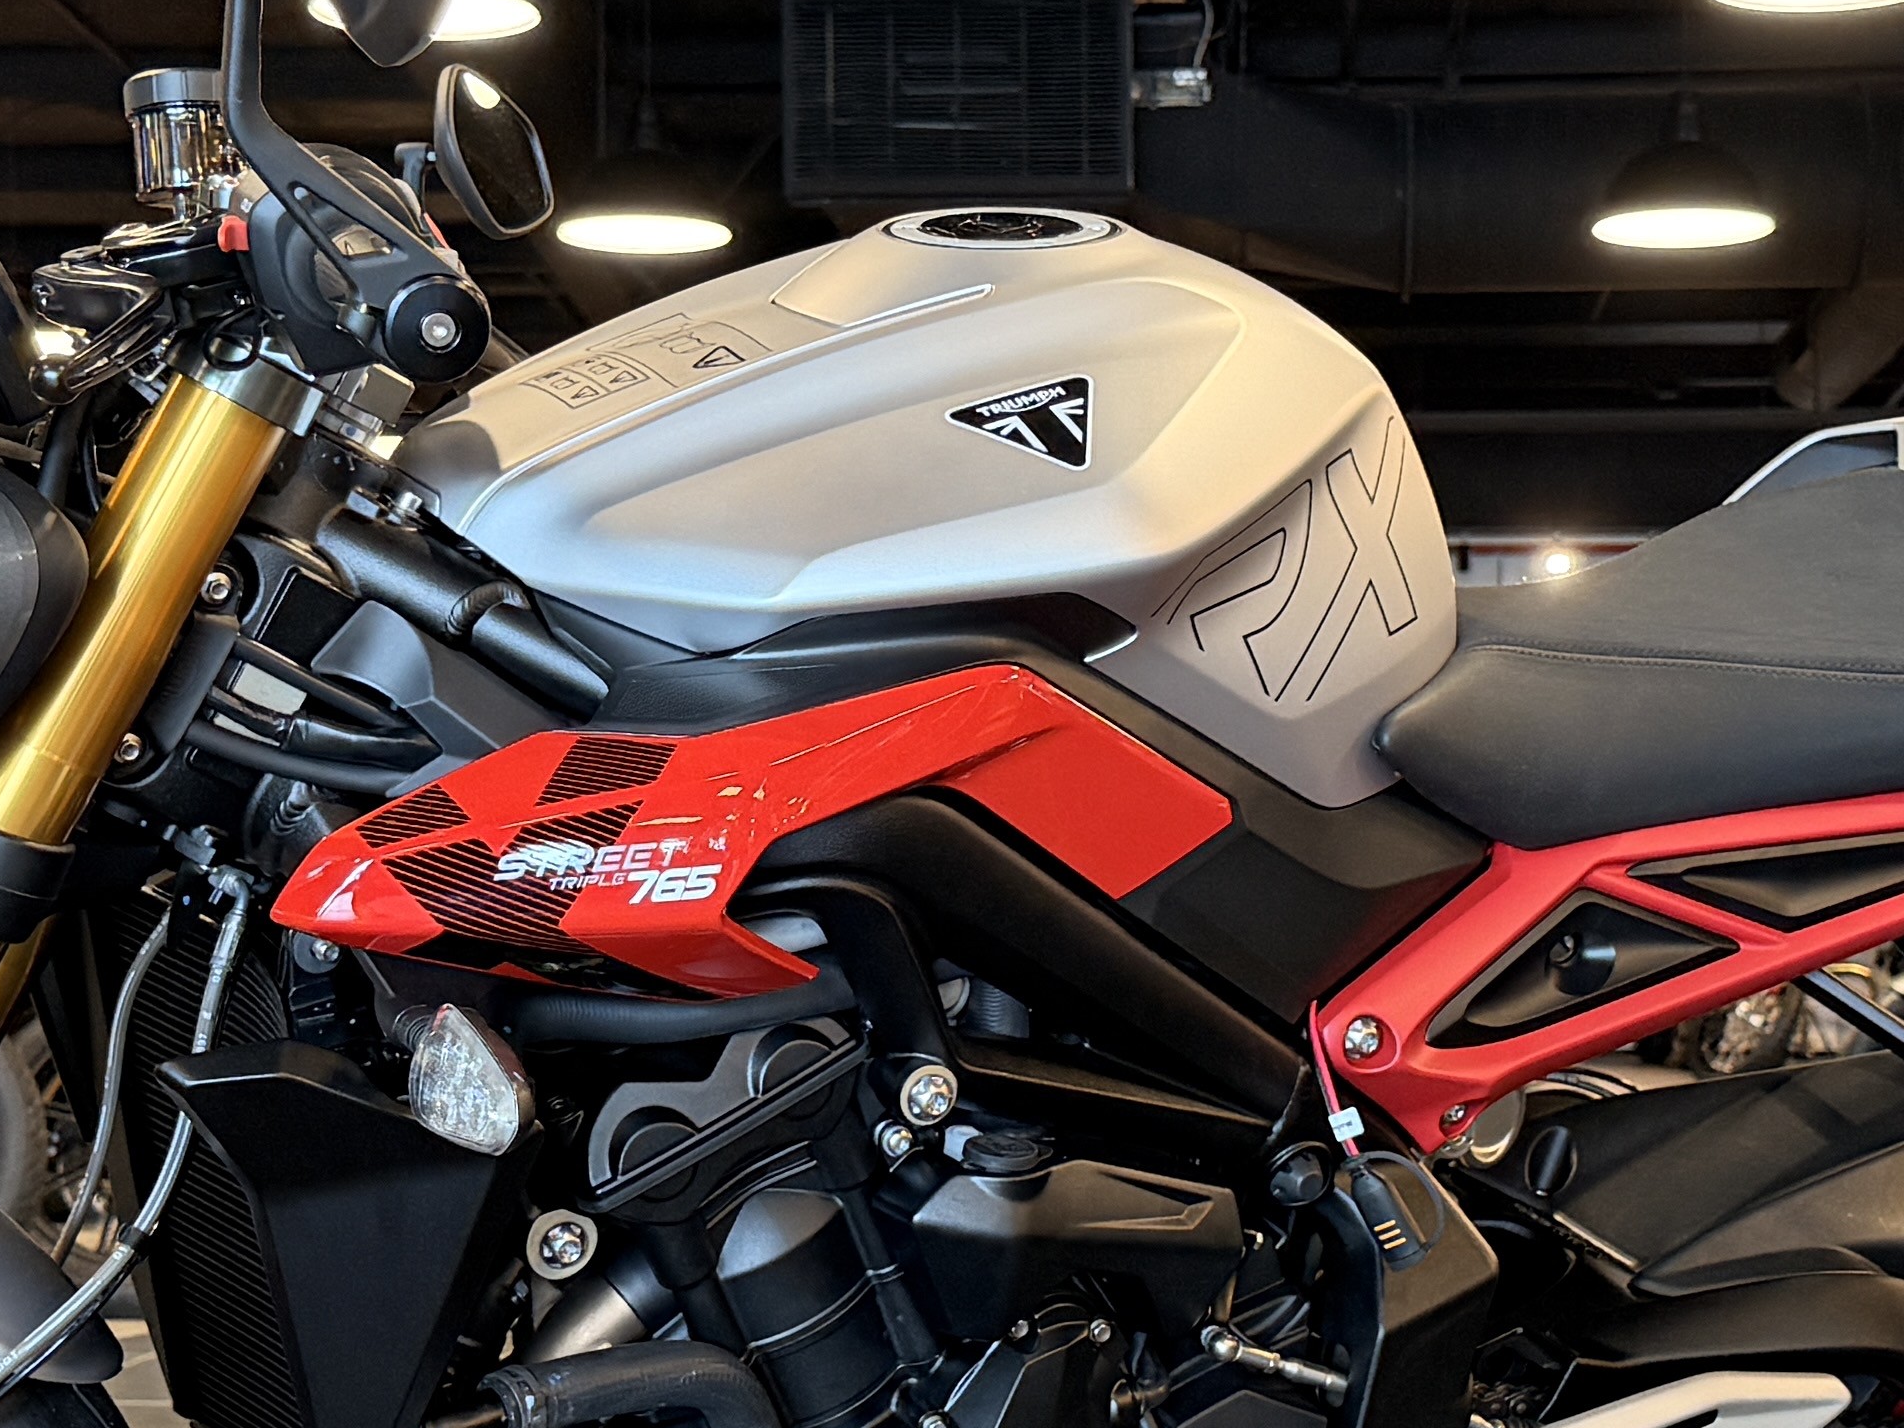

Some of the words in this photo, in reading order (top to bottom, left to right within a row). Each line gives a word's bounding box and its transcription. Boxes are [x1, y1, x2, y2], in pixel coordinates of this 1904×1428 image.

[975, 385, 1067, 418] TRIUMPH
[1151, 415, 1418, 703] RX
[493, 838, 686, 882] STREET
[549, 873, 625, 892] TRIPLE
[627, 864, 723, 906] 765
